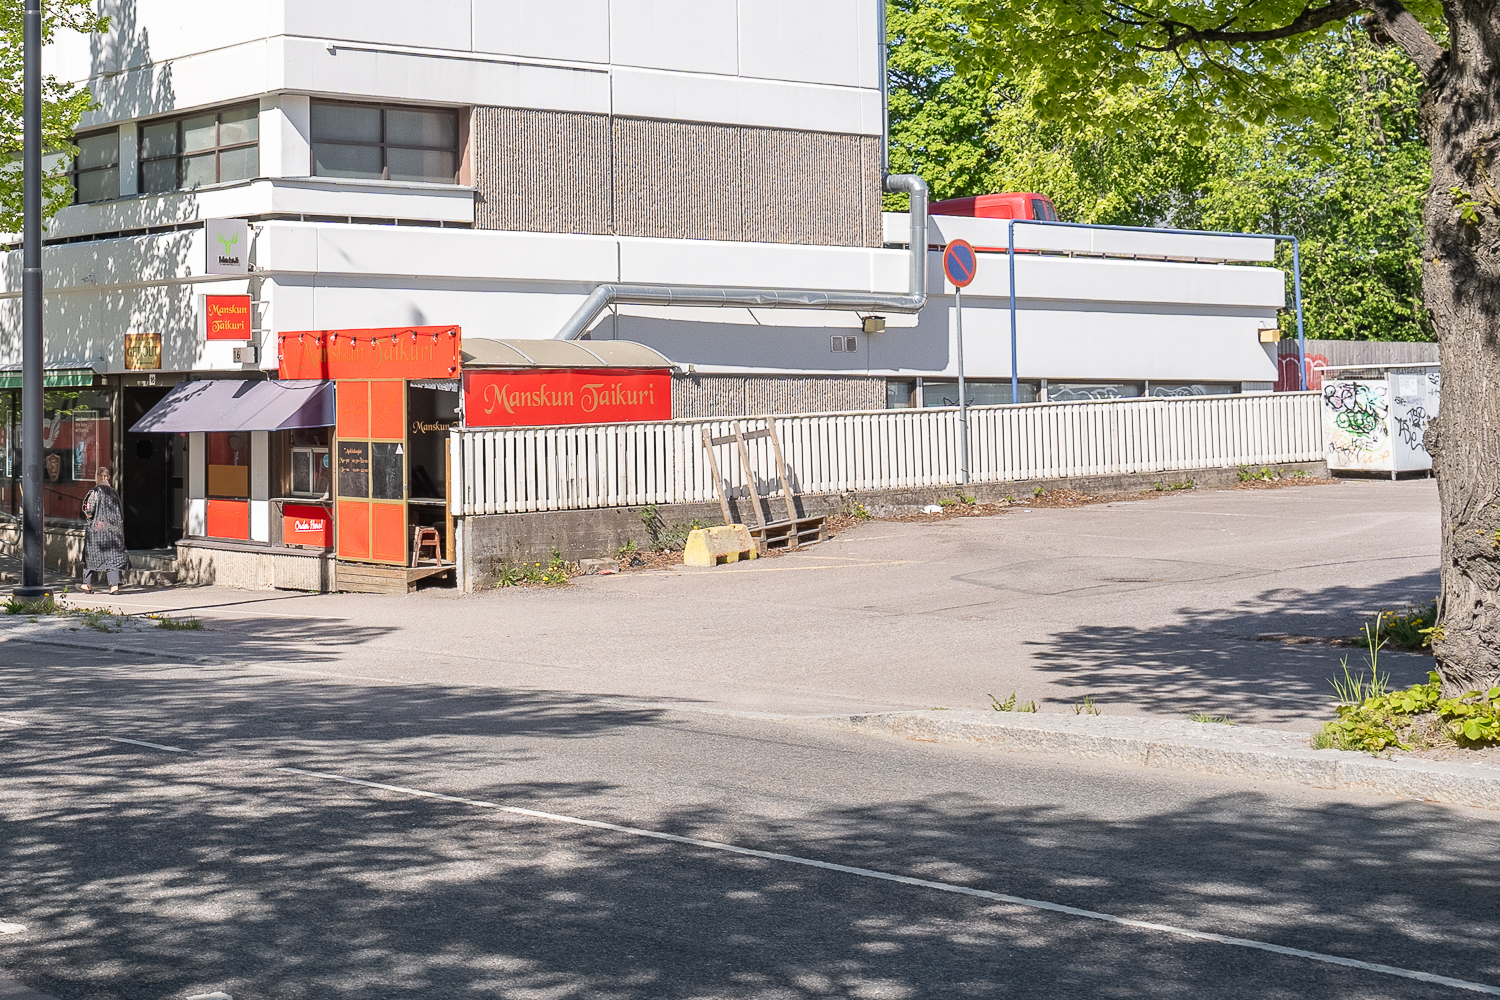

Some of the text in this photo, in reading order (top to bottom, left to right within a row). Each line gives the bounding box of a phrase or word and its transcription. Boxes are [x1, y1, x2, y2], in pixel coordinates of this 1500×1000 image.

[208, 304, 247, 316] Manskun
[211, 320, 244, 332] Taikuri
[143, 346, 158, 357] OUT
[297, 338, 433, 369] Manskun Taikuri
[484, 383, 655, 414] Manskun Taikuri
[412, 421, 449, 434] Manskun
